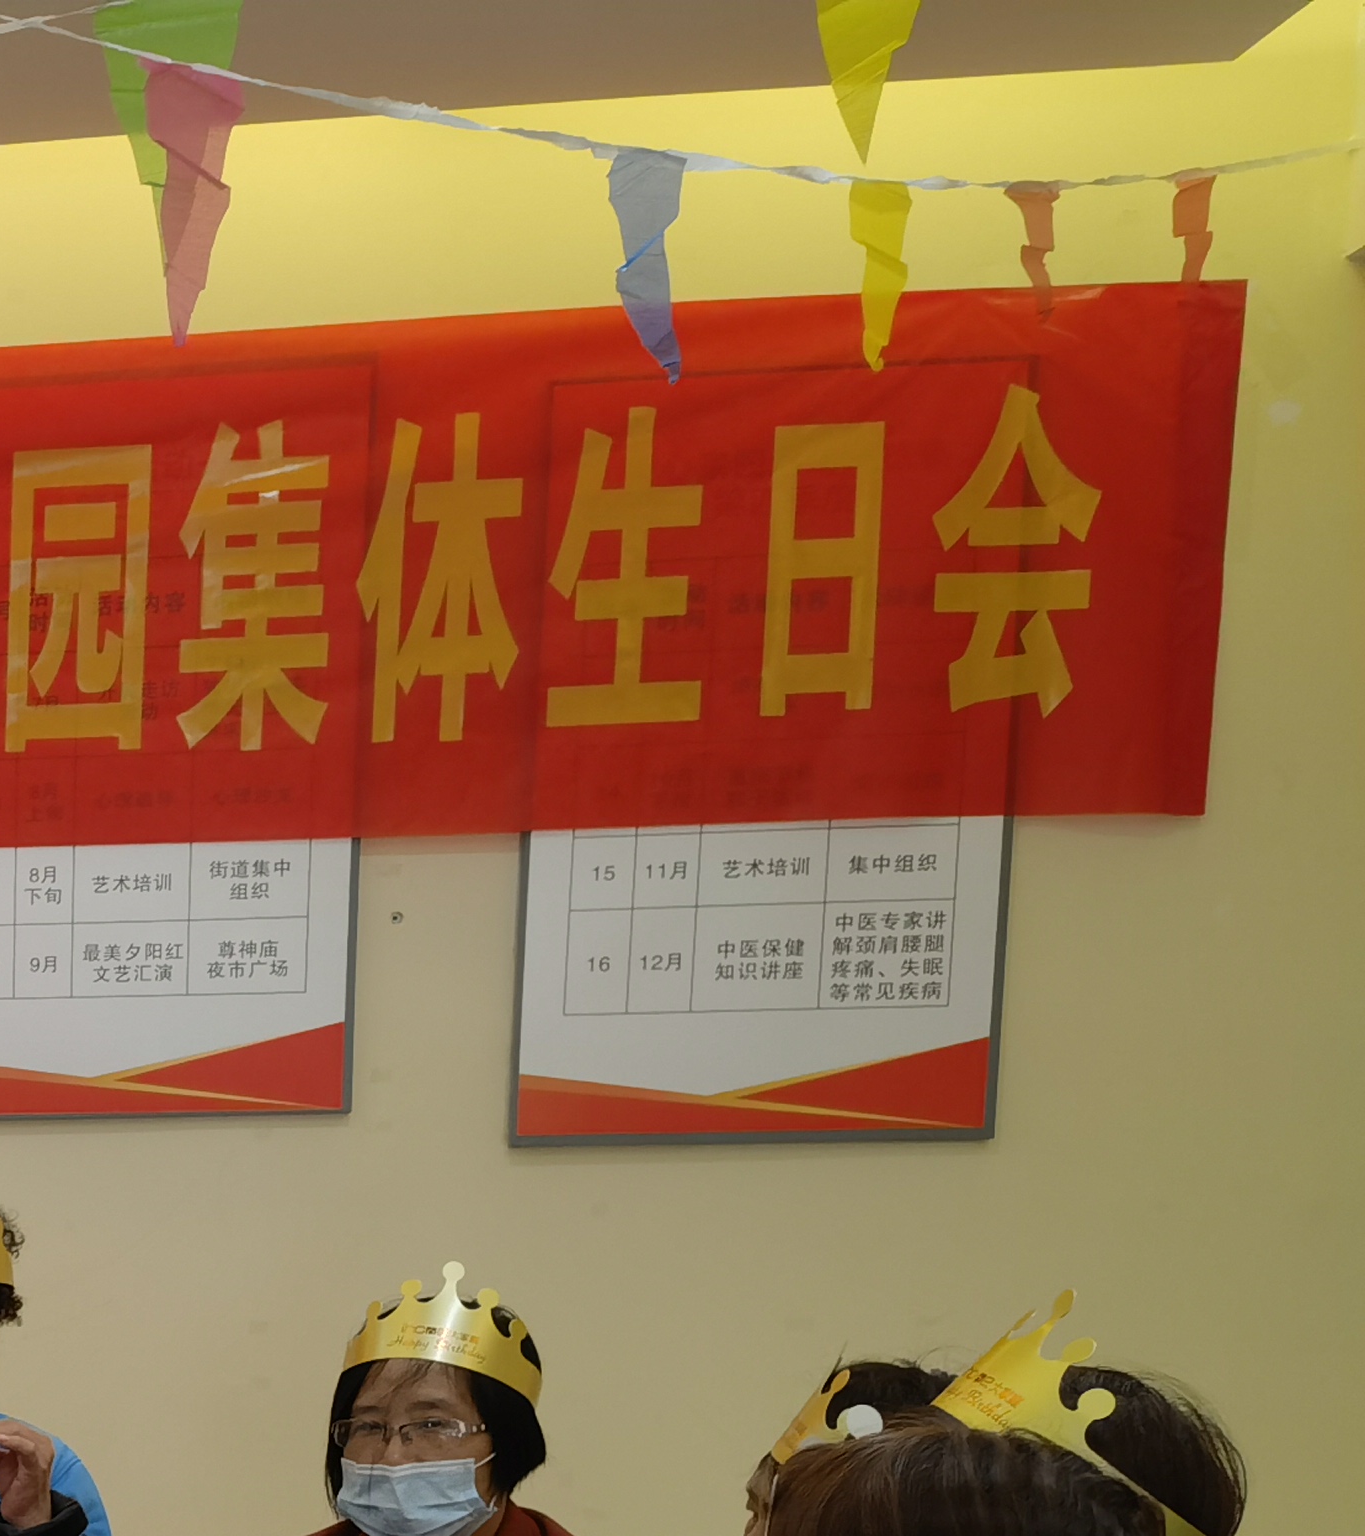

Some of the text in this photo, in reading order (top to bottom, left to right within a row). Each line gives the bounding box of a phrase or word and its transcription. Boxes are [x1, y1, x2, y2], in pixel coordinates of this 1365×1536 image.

[209, 858, 291, 880] 街道集中
[592, 864, 616, 882] 15
[646, 860, 688, 880] 11月
[722, 856, 811, 879] 艺术培训
[848, 853, 937, 875] 集中组织
[28, 865, 57, 884] 8月
[91, 872, 172, 894] 艺术培训
[23, 886, 63, 906] 下旬
[229, 881, 270, 900] 组织
[835, 910, 947, 933] 中医专家讲
[82, 942, 184, 963] 最美夕阳红
[717, 937, 805, 960] 中医保健
[29, 955, 57, 974] 9月
[206, 959, 289, 979] 夜市广场
[587, 955, 611, 973] 16
[640, 952, 682, 972] 12月
[714, 960, 805, 981] 知识讲座
[92, 963, 173, 983] 文艺汇演
[829, 980, 943, 1003] 等常见疾病
